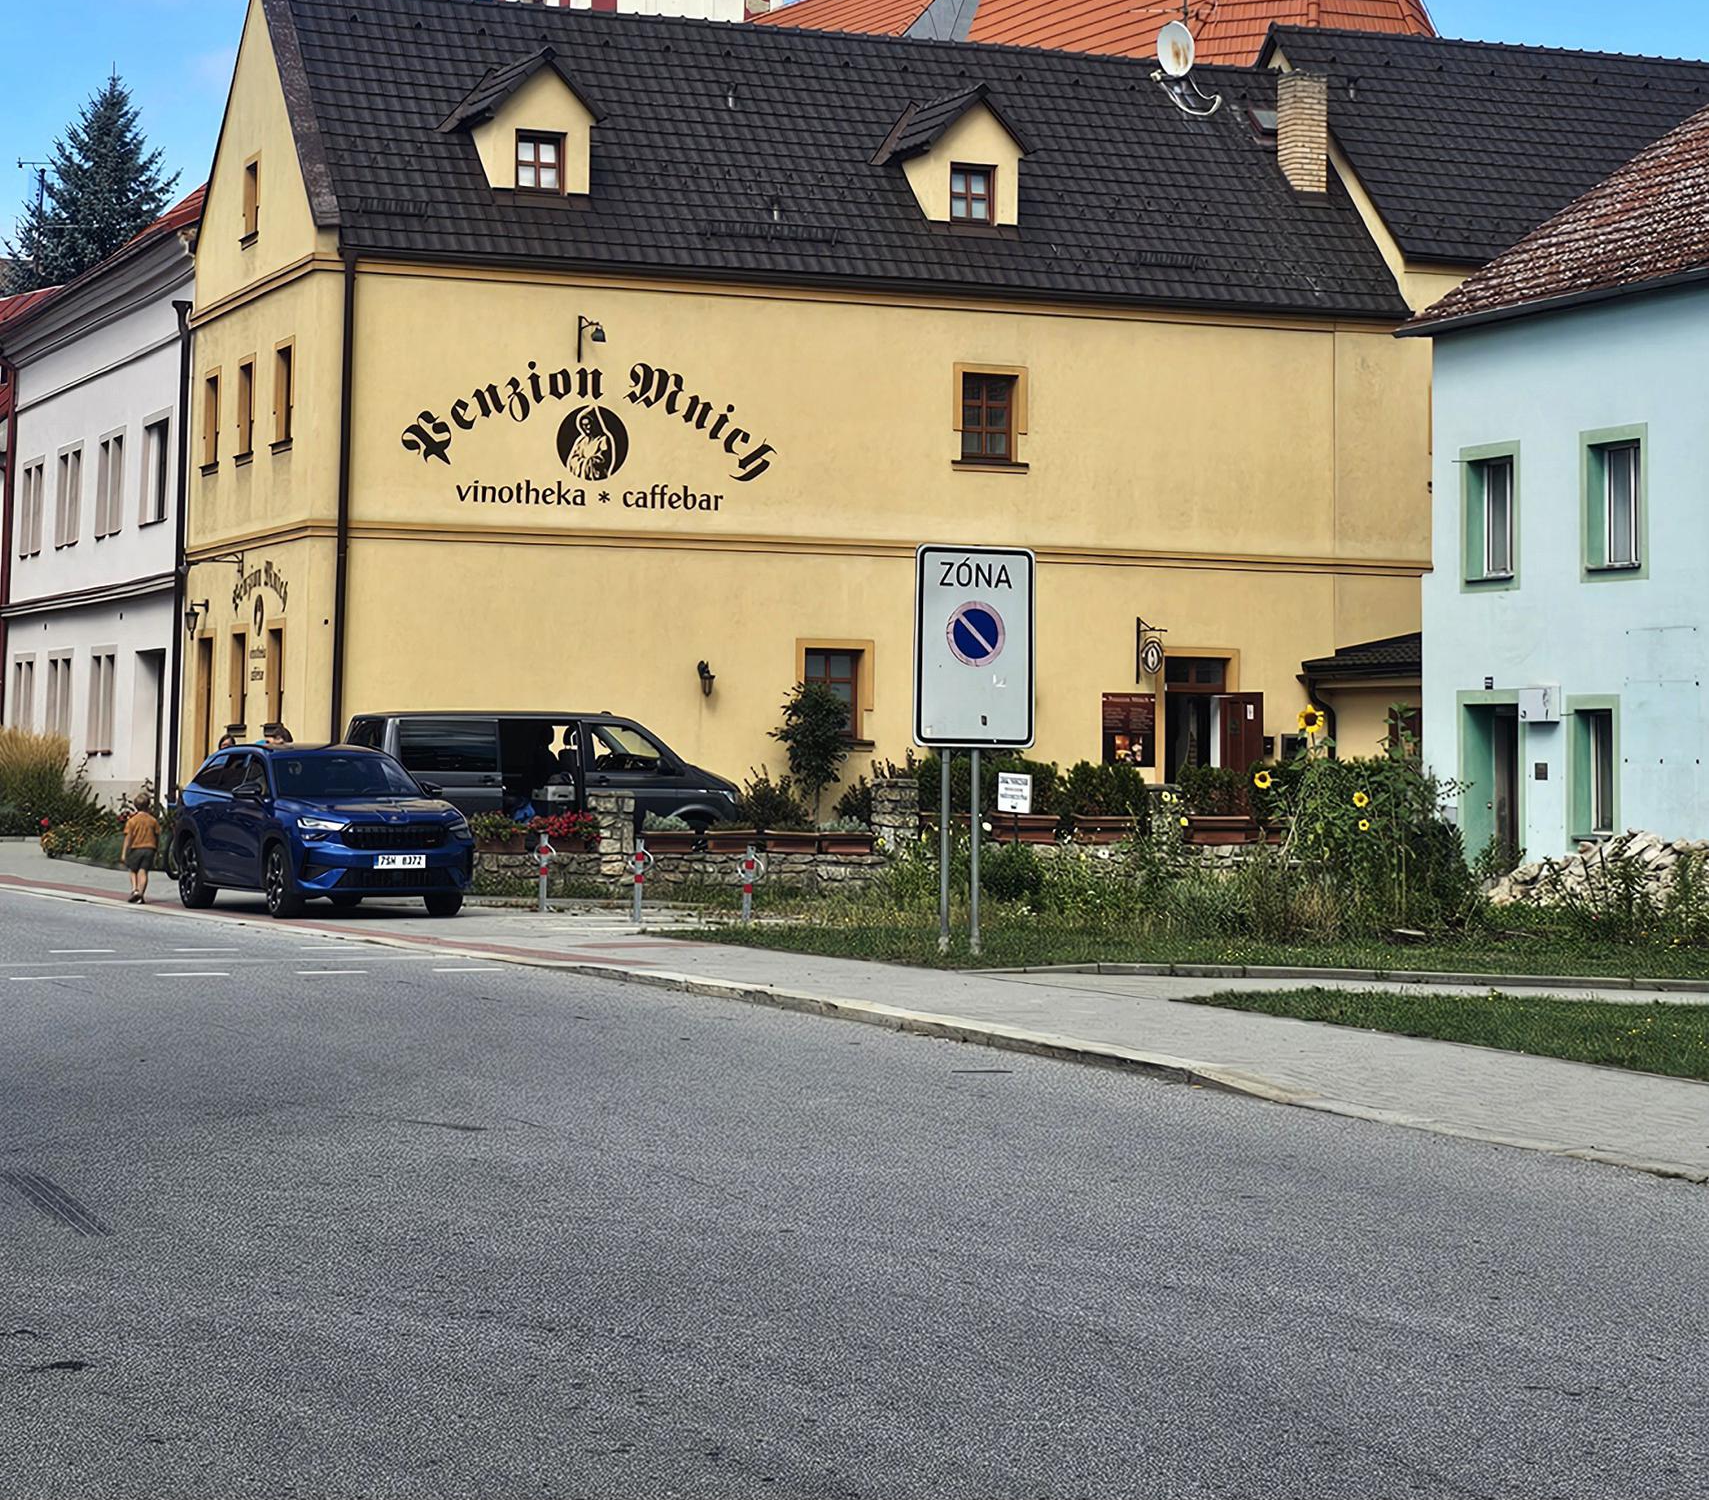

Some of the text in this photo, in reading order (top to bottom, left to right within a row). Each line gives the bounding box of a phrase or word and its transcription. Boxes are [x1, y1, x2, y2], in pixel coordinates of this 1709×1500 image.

[401, 361, 778, 482] Penzion Mnich
[456, 479, 724, 511] vinotheka caffebar
[939, 556, 1013, 589] ZÓNA
